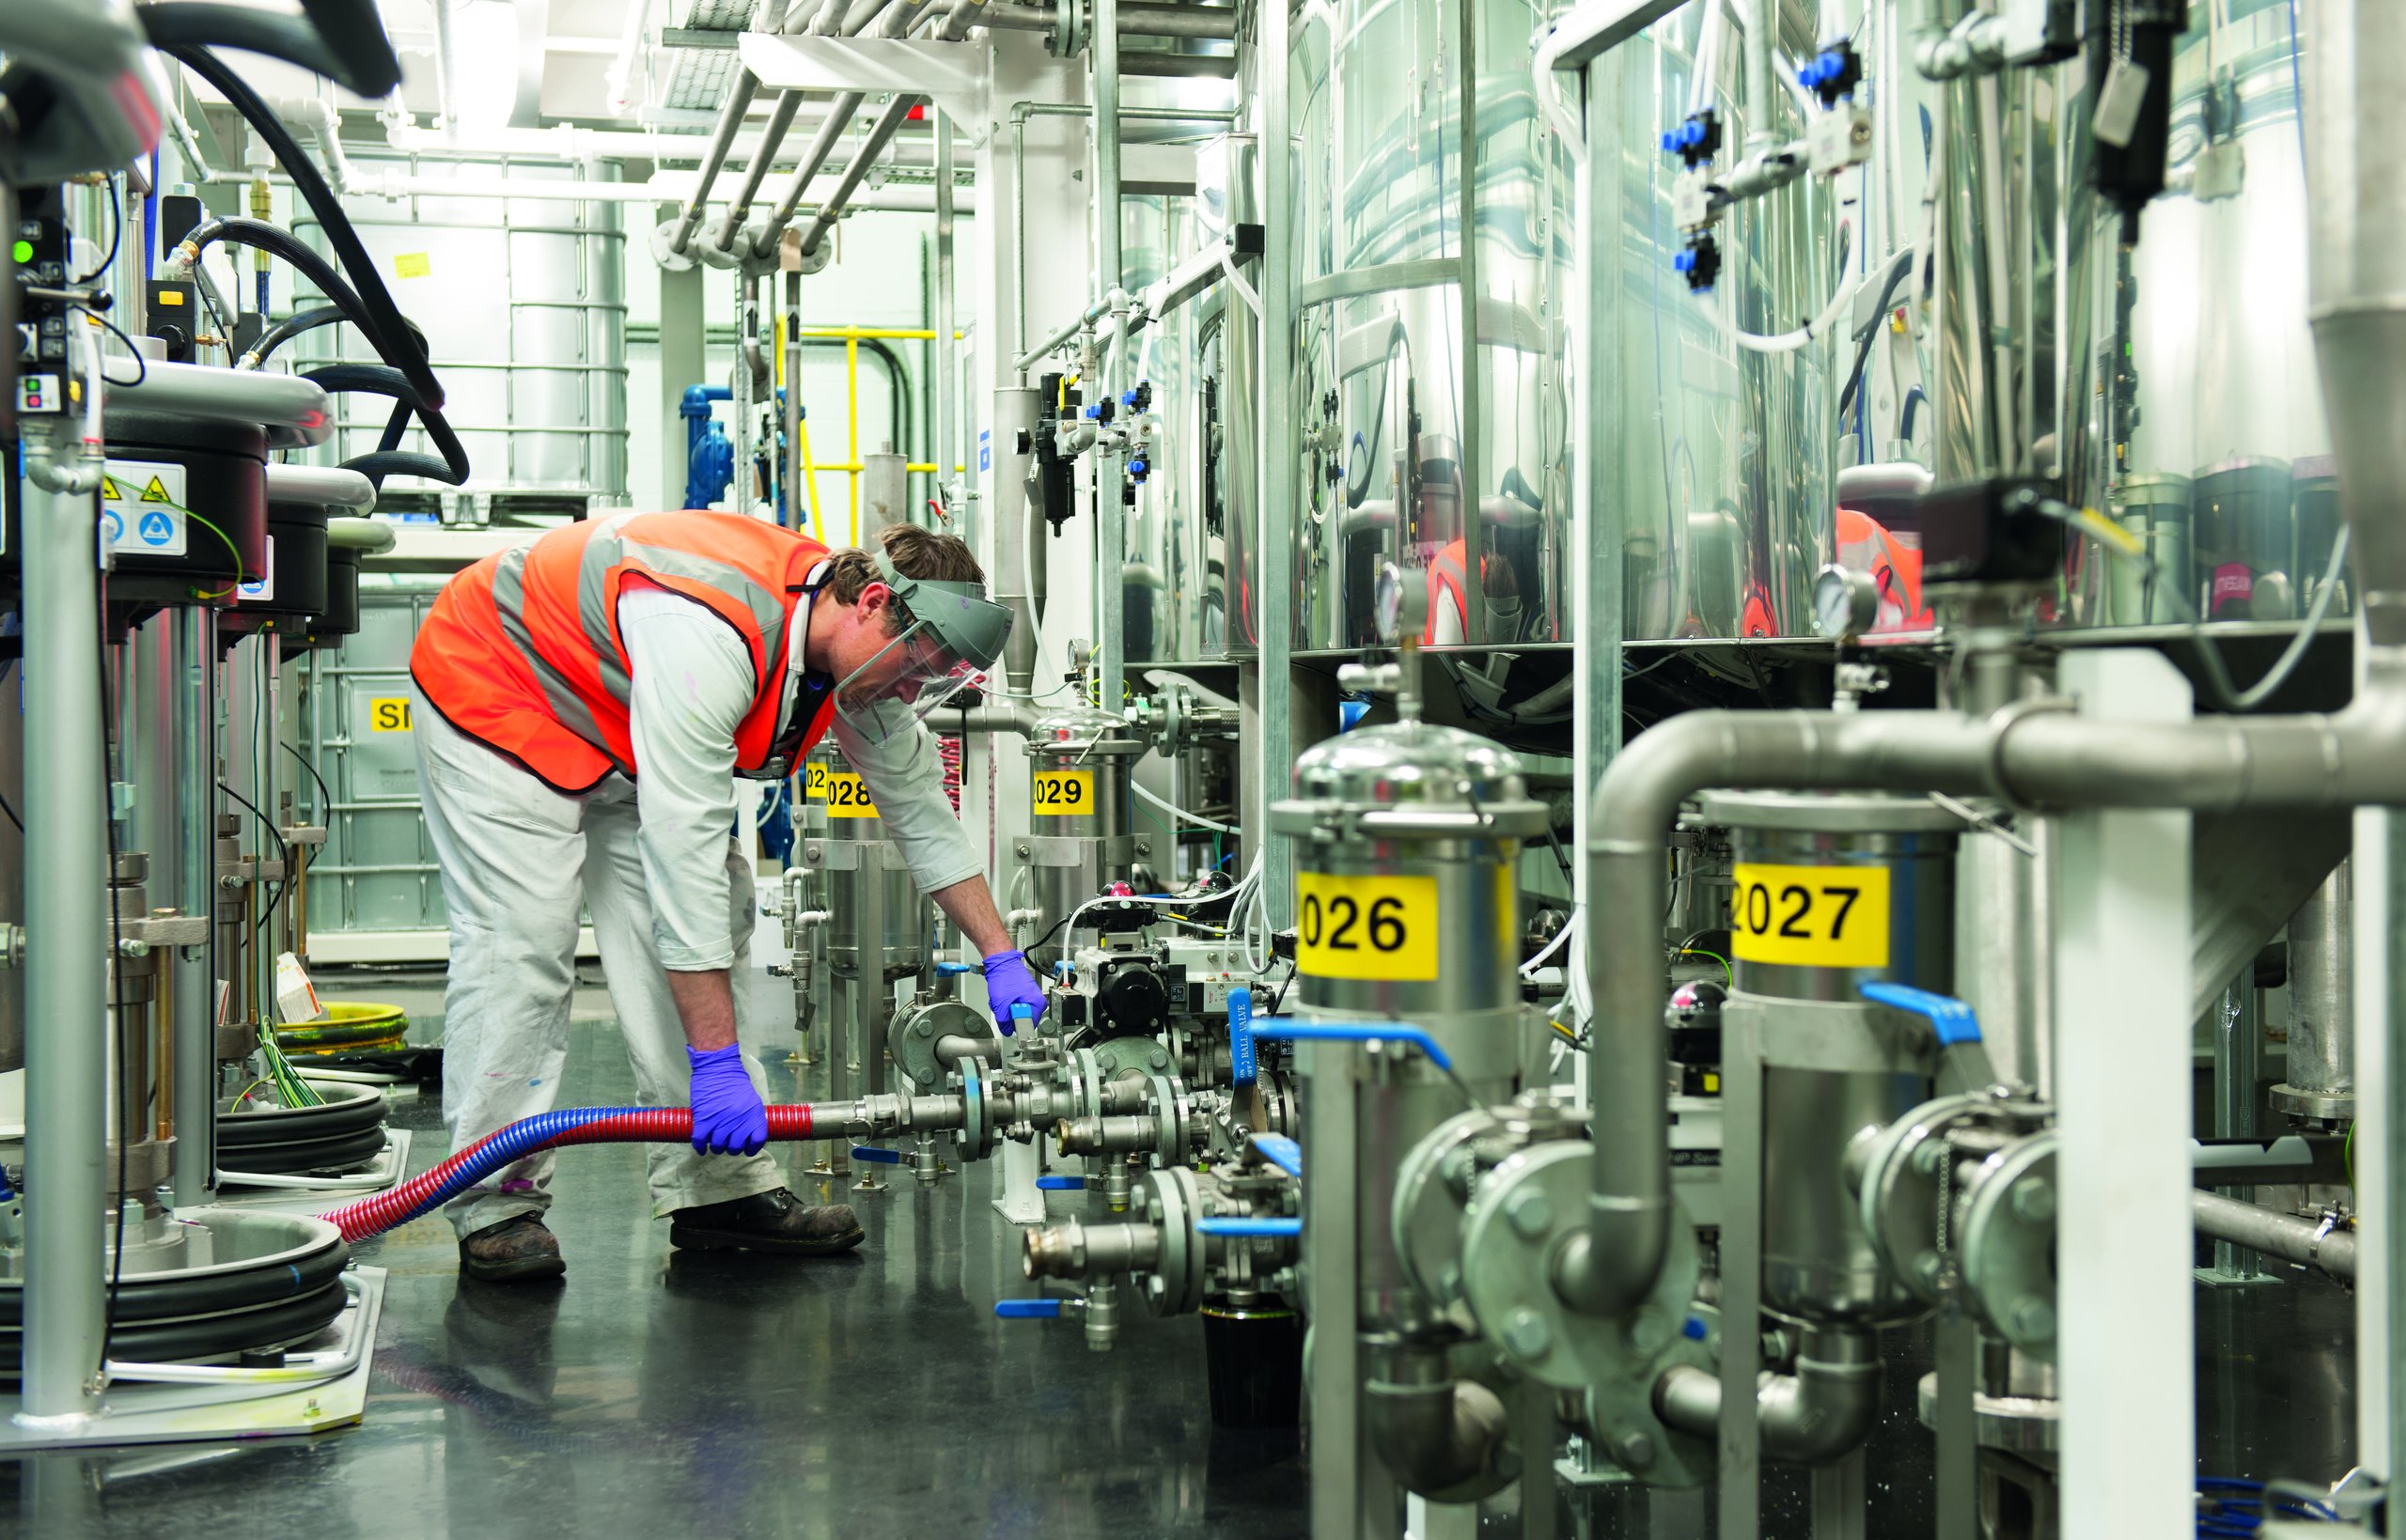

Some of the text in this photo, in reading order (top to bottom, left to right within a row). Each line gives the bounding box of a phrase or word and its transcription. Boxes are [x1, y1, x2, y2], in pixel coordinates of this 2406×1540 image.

[1034, 779, 1082, 804] 029
[1238, 1004, 1249, 1059] BALL VALVE
